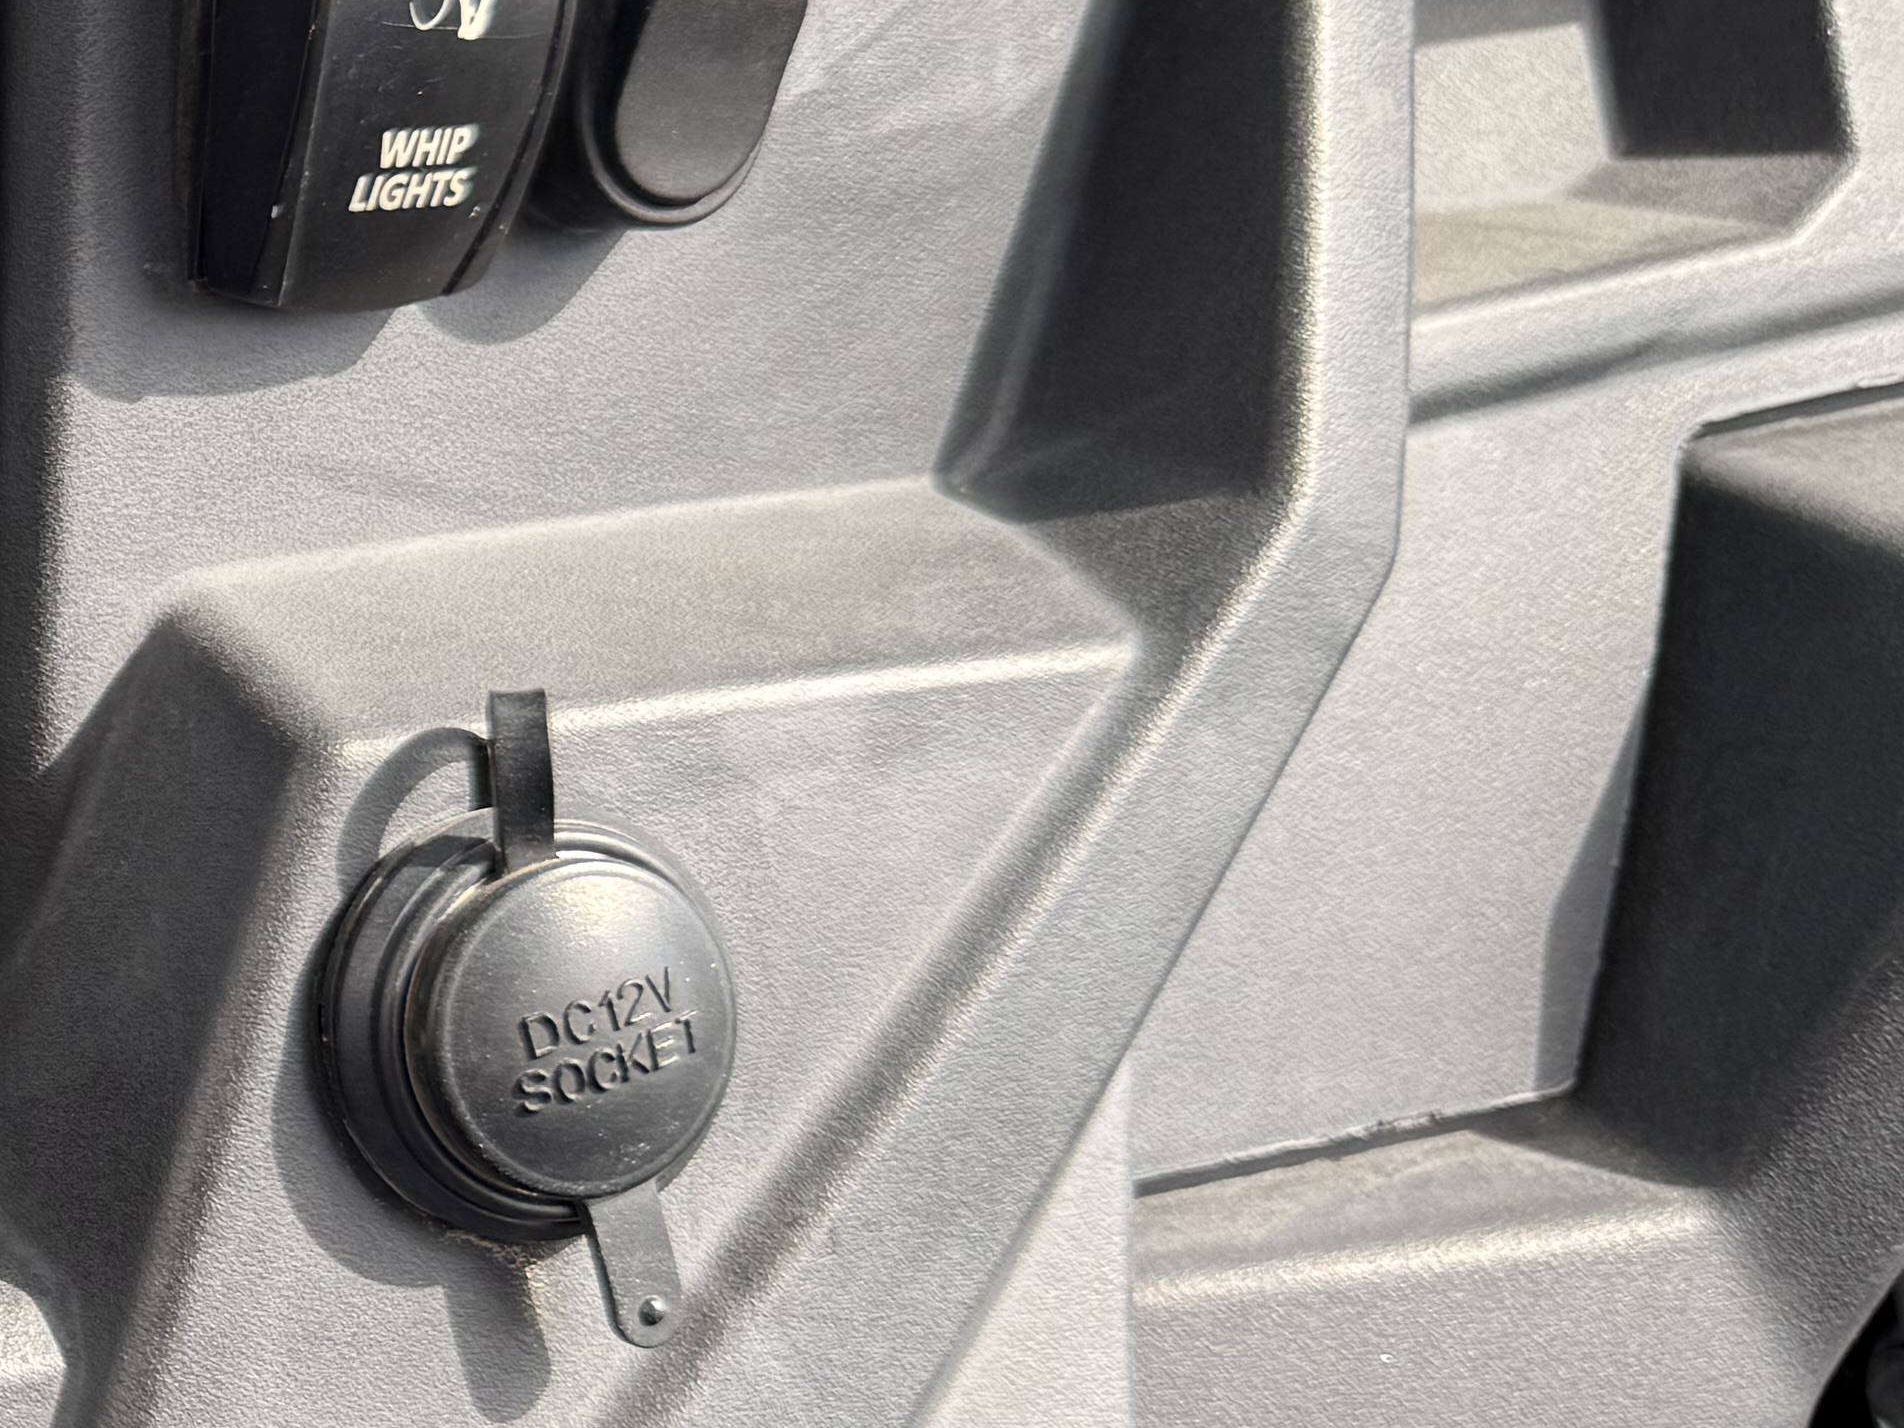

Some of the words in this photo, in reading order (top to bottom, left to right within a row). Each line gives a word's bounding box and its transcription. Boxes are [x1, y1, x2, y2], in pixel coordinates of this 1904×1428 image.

[380, 124, 480, 169] WHIP
[348, 167, 477, 212] LIGHTS
[512, 1010, 698, 1117] SOCKET
